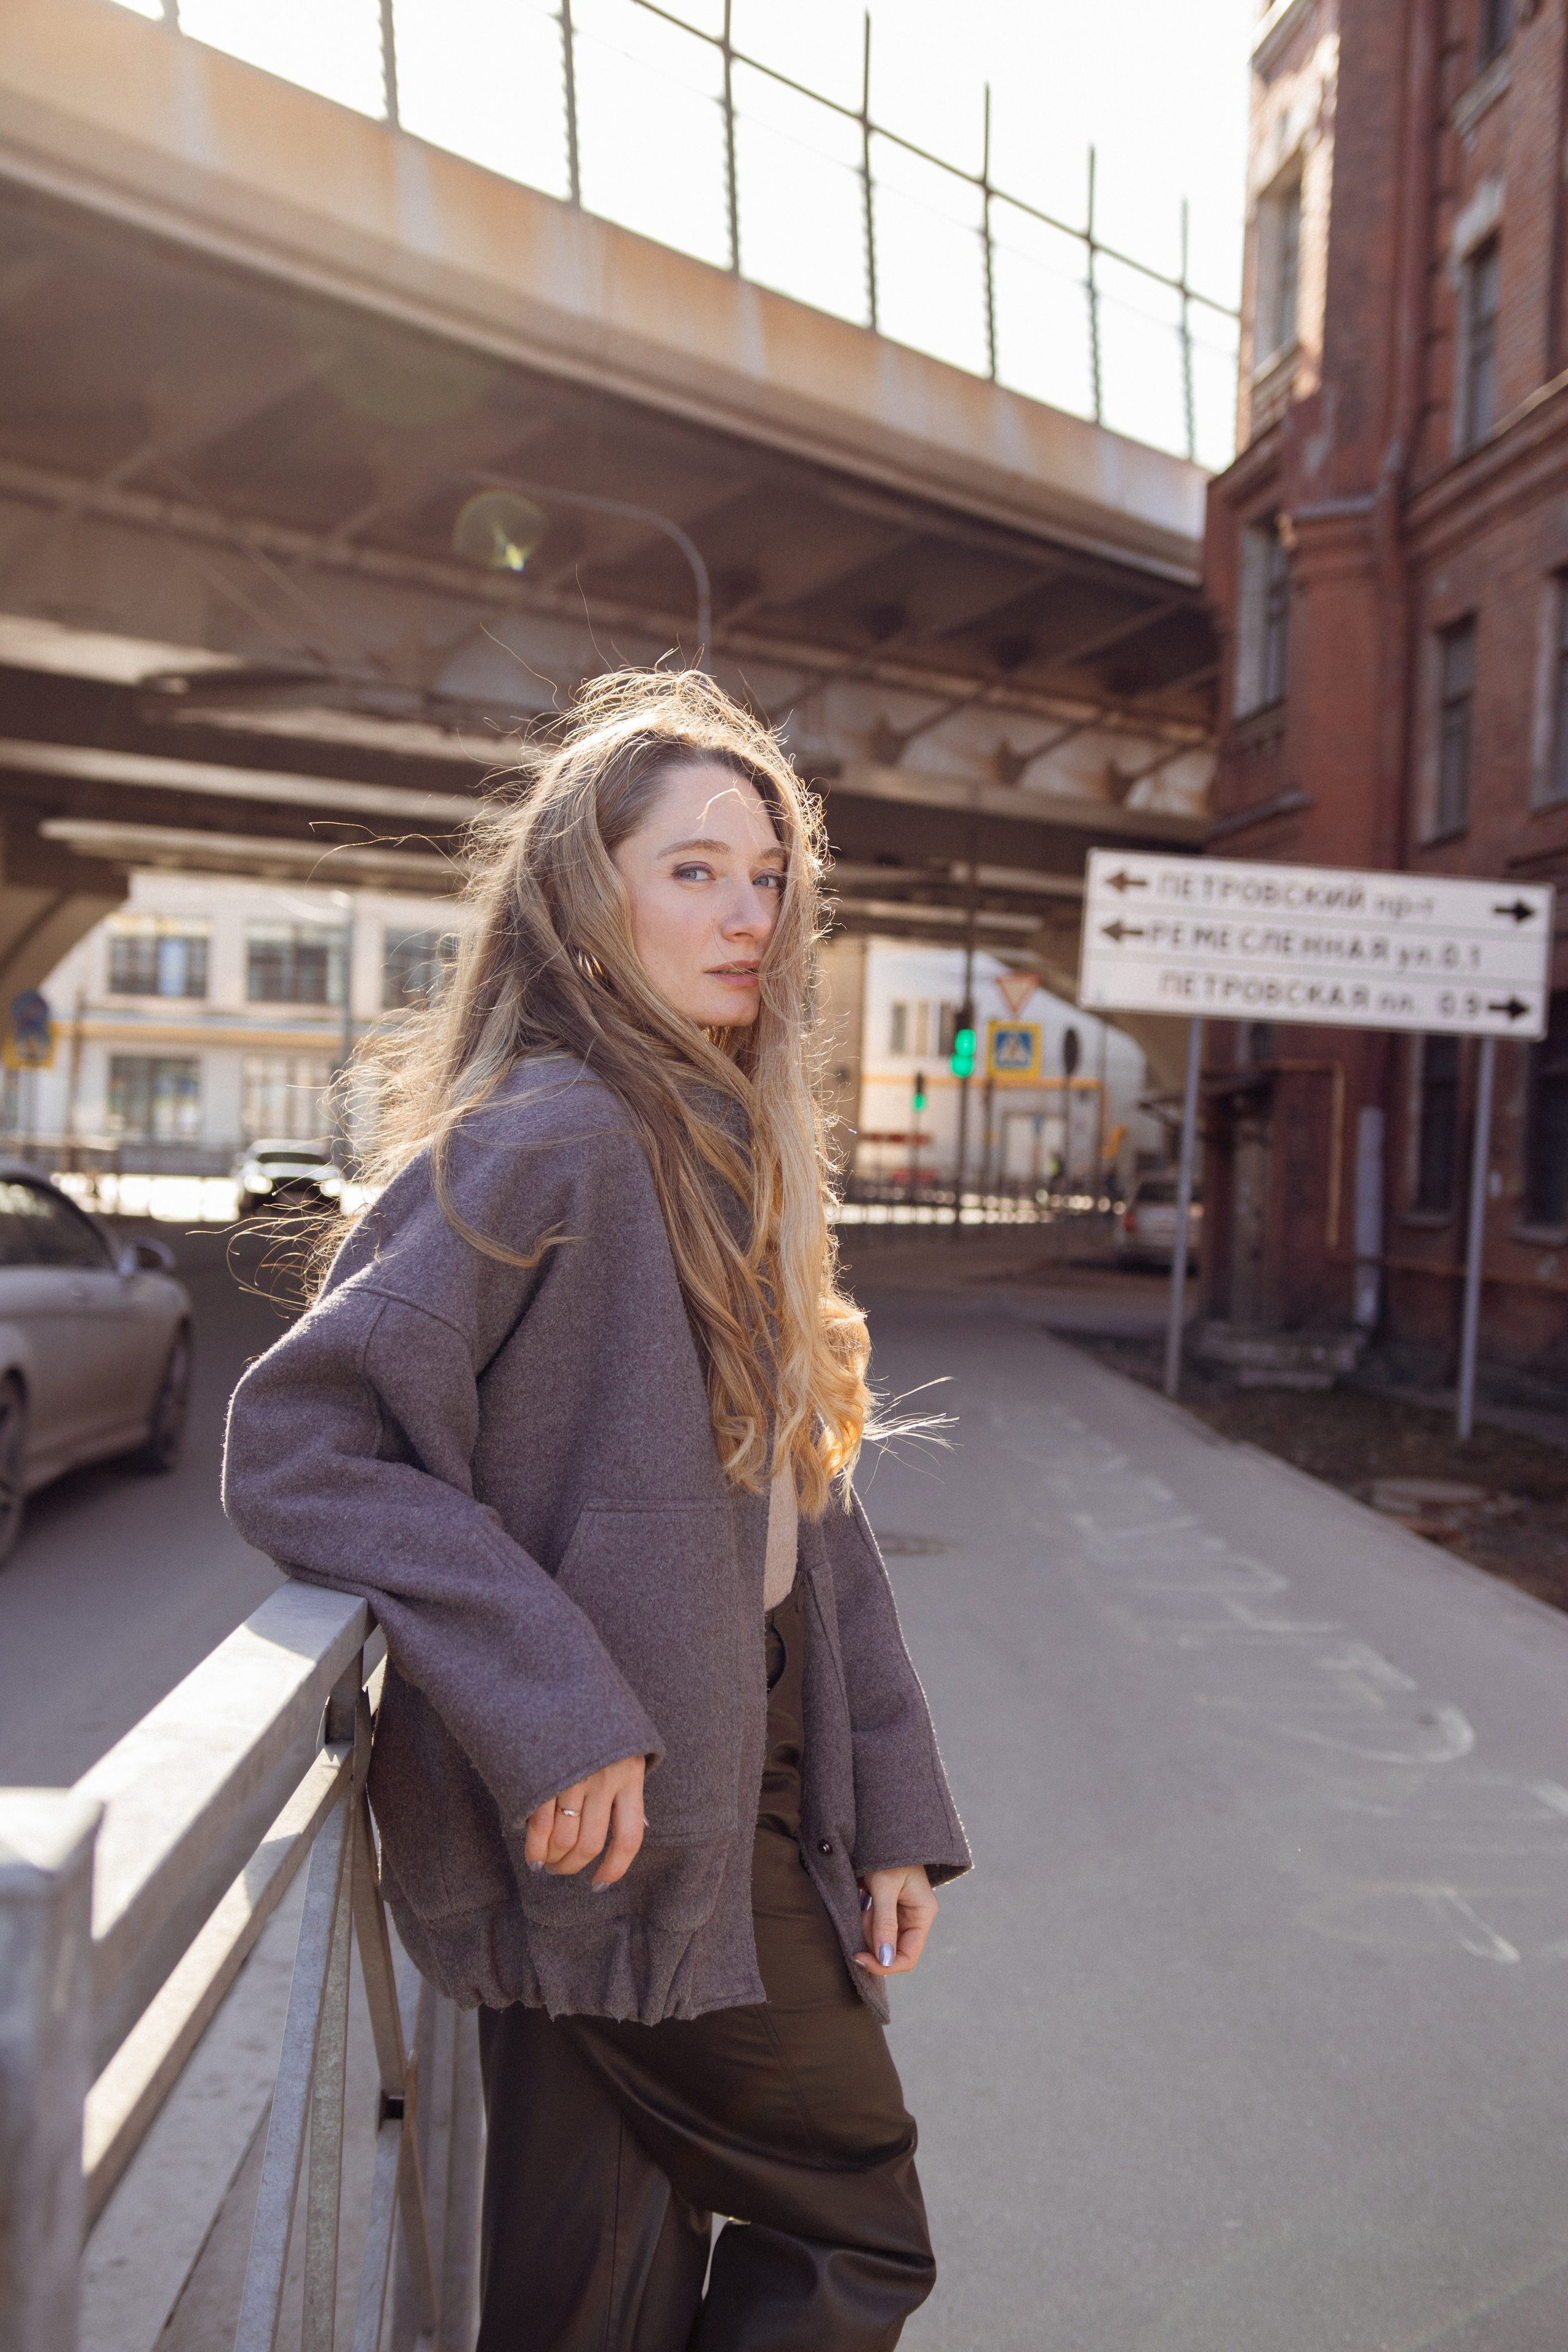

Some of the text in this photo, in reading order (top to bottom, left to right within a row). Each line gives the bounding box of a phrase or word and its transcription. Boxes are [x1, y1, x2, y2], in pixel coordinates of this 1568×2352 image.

[1157, 870, 1365, 911] ПЕТРОВСКИЙ
[1150, 920, 1389, 961] РЕМЕСЛЕННАЯ
[1159, 968, 1370, 1009] ПЕТРОВСКАЯ
